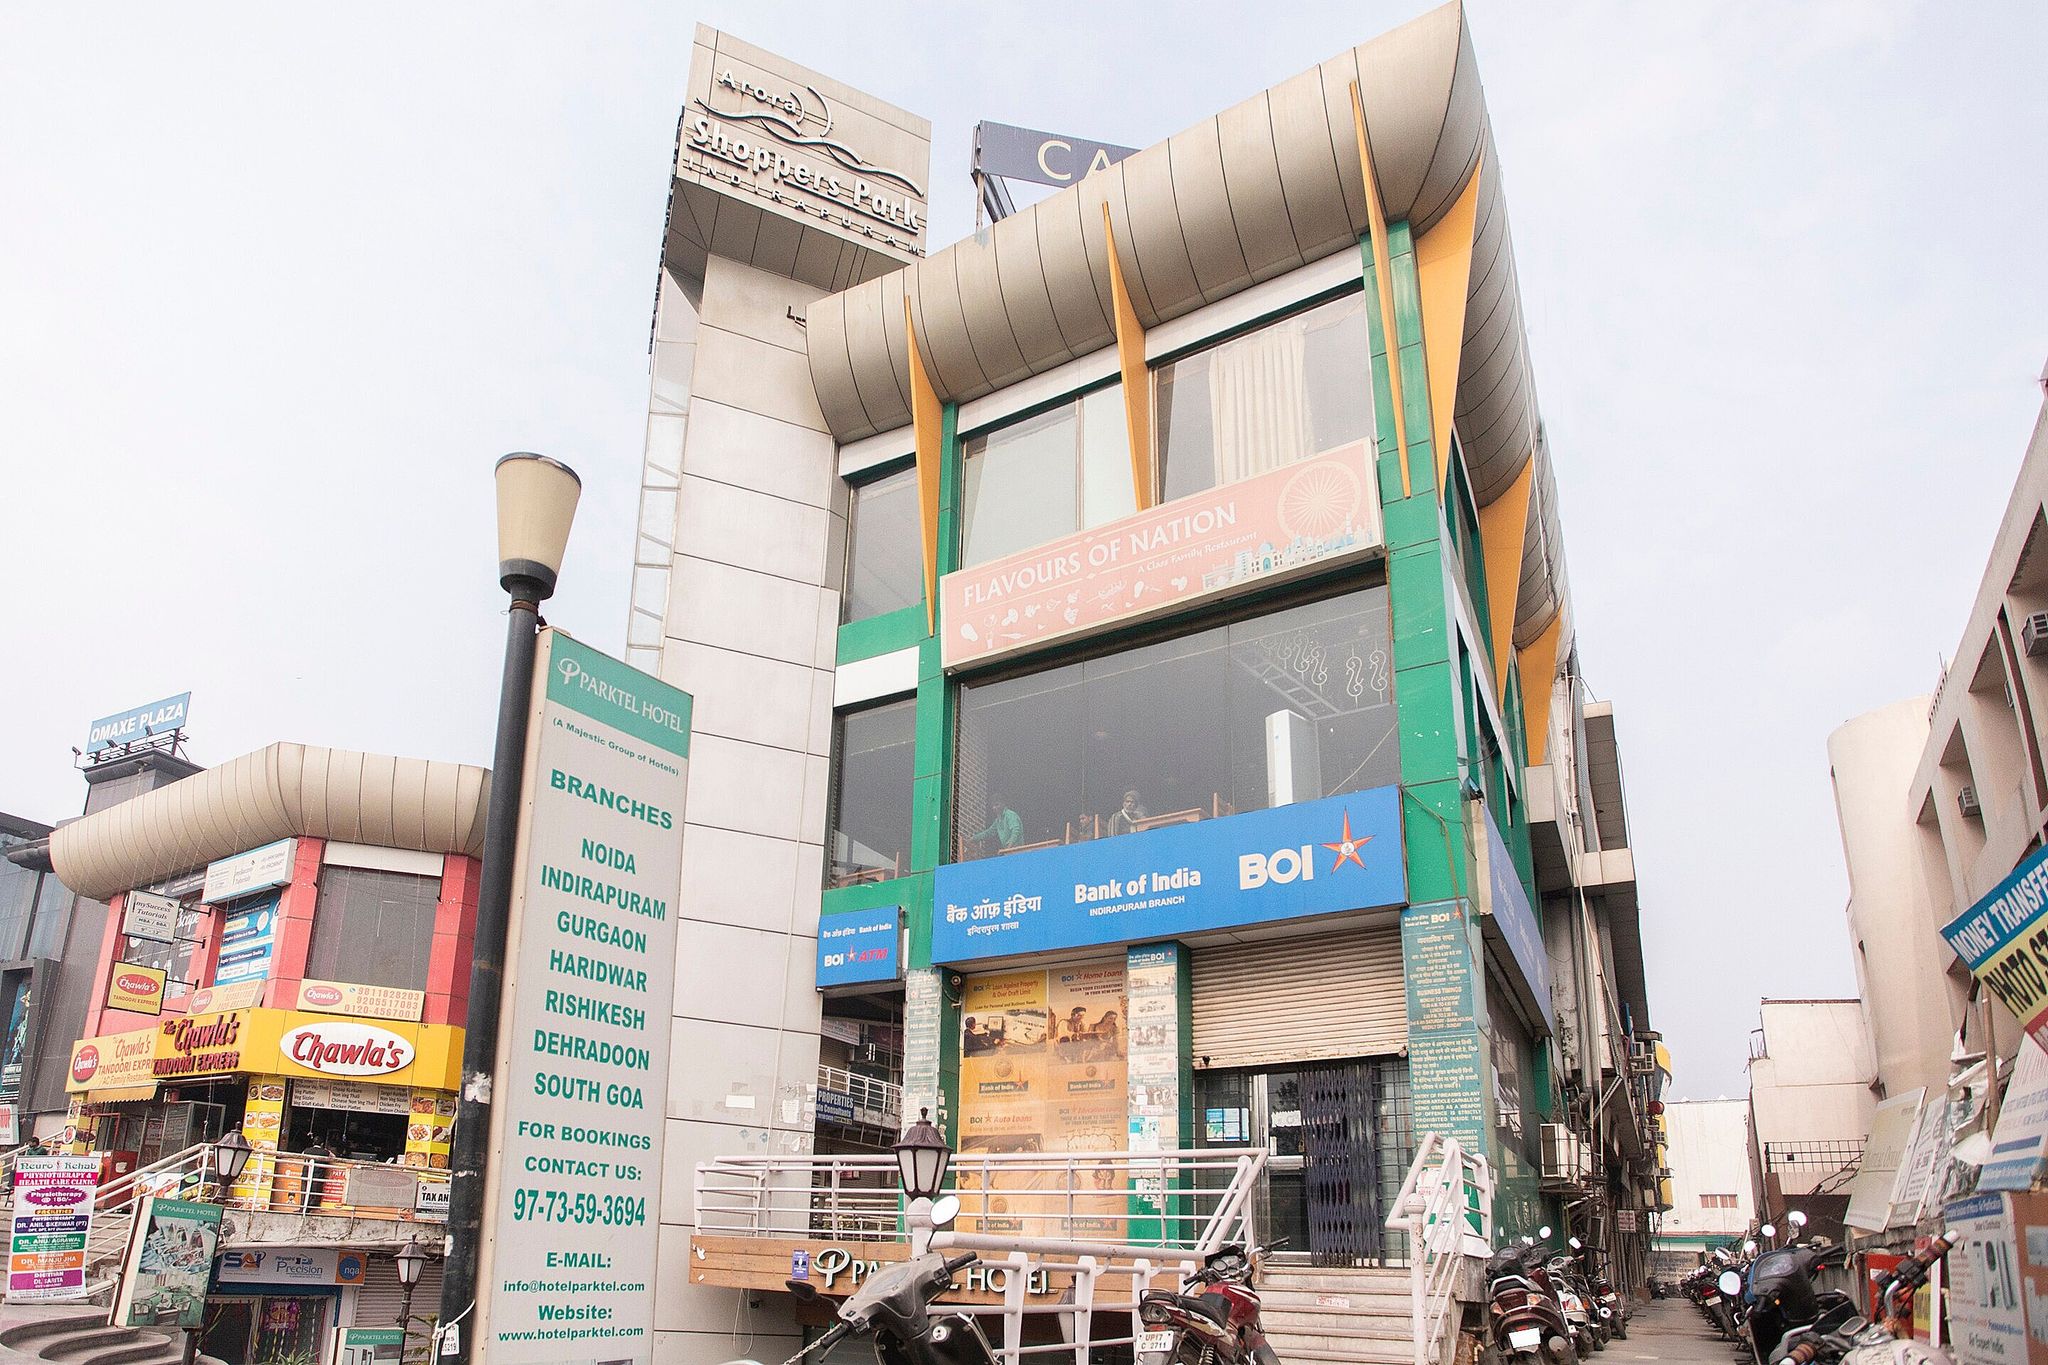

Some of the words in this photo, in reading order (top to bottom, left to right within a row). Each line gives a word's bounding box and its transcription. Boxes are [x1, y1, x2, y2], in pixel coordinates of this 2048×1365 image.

[719, 68, 798, 114] Arora
[692, 116, 840, 197] Shoppers
[853, 178, 919, 229] Park
[687, 157, 921, 256] INDIRAPURAM
[963, 552, 1081, 608] FLAVOURS
[1088, 538, 1121, 566] OF
[1129, 501, 1237, 555] NATION
[1137, 565, 1145, 574] A
[1147, 559, 1168, 571] Class
[1170, 549, 1203, 564] Family
[1204, 532, 1258, 553] Restaurant
[579, 672, 639, 714] PARKTEL
[641, 701, 683, 734] HOTEL
[90, 717, 137, 744] OMAXE
[140, 703, 184, 730] PLAZA
[552, 716, 564, 728] (A
[566, 722, 606, 746] Majestic
[608, 740, 635, 759] Group
[637, 754, 648, 762] of
[649, 757, 679, 777] Hotels)
[551, 768, 673, 830] BRANCHES
[581, 838, 636, 875] NOIDA
[1074, 879, 1122, 904] Bank
[1126, 874, 1147, 895] of
[1152, 867, 1201, 892] India
[1238, 844, 1314, 890] BOI
[541, 865, 666, 921] INDIRAPURAM
[1089, 901, 1147, 916] INDIRAPURAM
[1148, 895, 1185, 909] BRANCH
[136, 901, 171, 913] mySuccess
[137, 909, 167, 919] Tutorials
[946, 904, 968, 923] बैंक
[1003, 893, 1042, 919] इंडिया
[1431, 913, 1450, 924] BOI
[557, 911, 647, 954] GURGAON
[859, 925, 872, 934] Bank
[879, 922, 892, 930] India
[1950, 911, 1999, 964] MONEY
[824, 953, 844, 967] BOI
[858, 947, 889, 962] ATM
[1150, 952, 1165, 961] BOI
[550, 949, 647, 993] HARIDWAR
[1104, 970, 1122, 978] Loans
[1982, 948, 2047, 1018] PHOTO
[119, 978, 156, 992] Chawla's
[307, 988, 339, 1001] Chawla's
[358, 987, 420, 1001] 9811828203
[137, 999, 158, 1007] EXPRESS
[545, 990, 645, 1031] RISHIKESH
[175, 1013, 240, 1055] Chawla's
[116, 1034, 151, 1062] Chawla's
[292, 1032, 404, 1069] Chawla's
[533, 1029, 650, 1071] DEHRADOON
[98, 1062, 131, 1075] TANDOORI
[132, 1058, 154, 1071] EXPR
[153, 1055, 196, 1075] TANDOORI
[197, 1051, 240, 1071] EXPRESS
[534, 1072, 600, 1103] SOUTH
[606, 1083, 644, 1110] GOA
[818, 1090, 854, 1109] PROPERTIES
[994, 1115, 1010, 1123] Auto
[1012, 1114, 1032, 1122] Loans
[518, 1120, 555, 1139] FOR
[561, 1126, 651, 1150] BOOKINGS
[20, 1162, 54, 1171] Neuro
[23, 1172, 86, 1180] PHYSIOTHERAPY
[525, 1156, 609, 1178] CONTACT
[615, 1165, 642, 1181] US:
[422, 1193, 437, 1201] TAX
[513, 1188, 646, 1226] 97-73-59-3694
[196, 1209, 218, 1217] HOTEL
[276, 1261, 323, 1274] Precision
[546, 1252, 612, 1268] E-MAIL:
[503, 1280, 645, 1294] info@hotelparktel.com
[966, 1268, 1057, 1294] HOEL
[538, 1304, 613, 1321] Website:
[498, 1326, 644, 1341] www.hotelparktel.com
